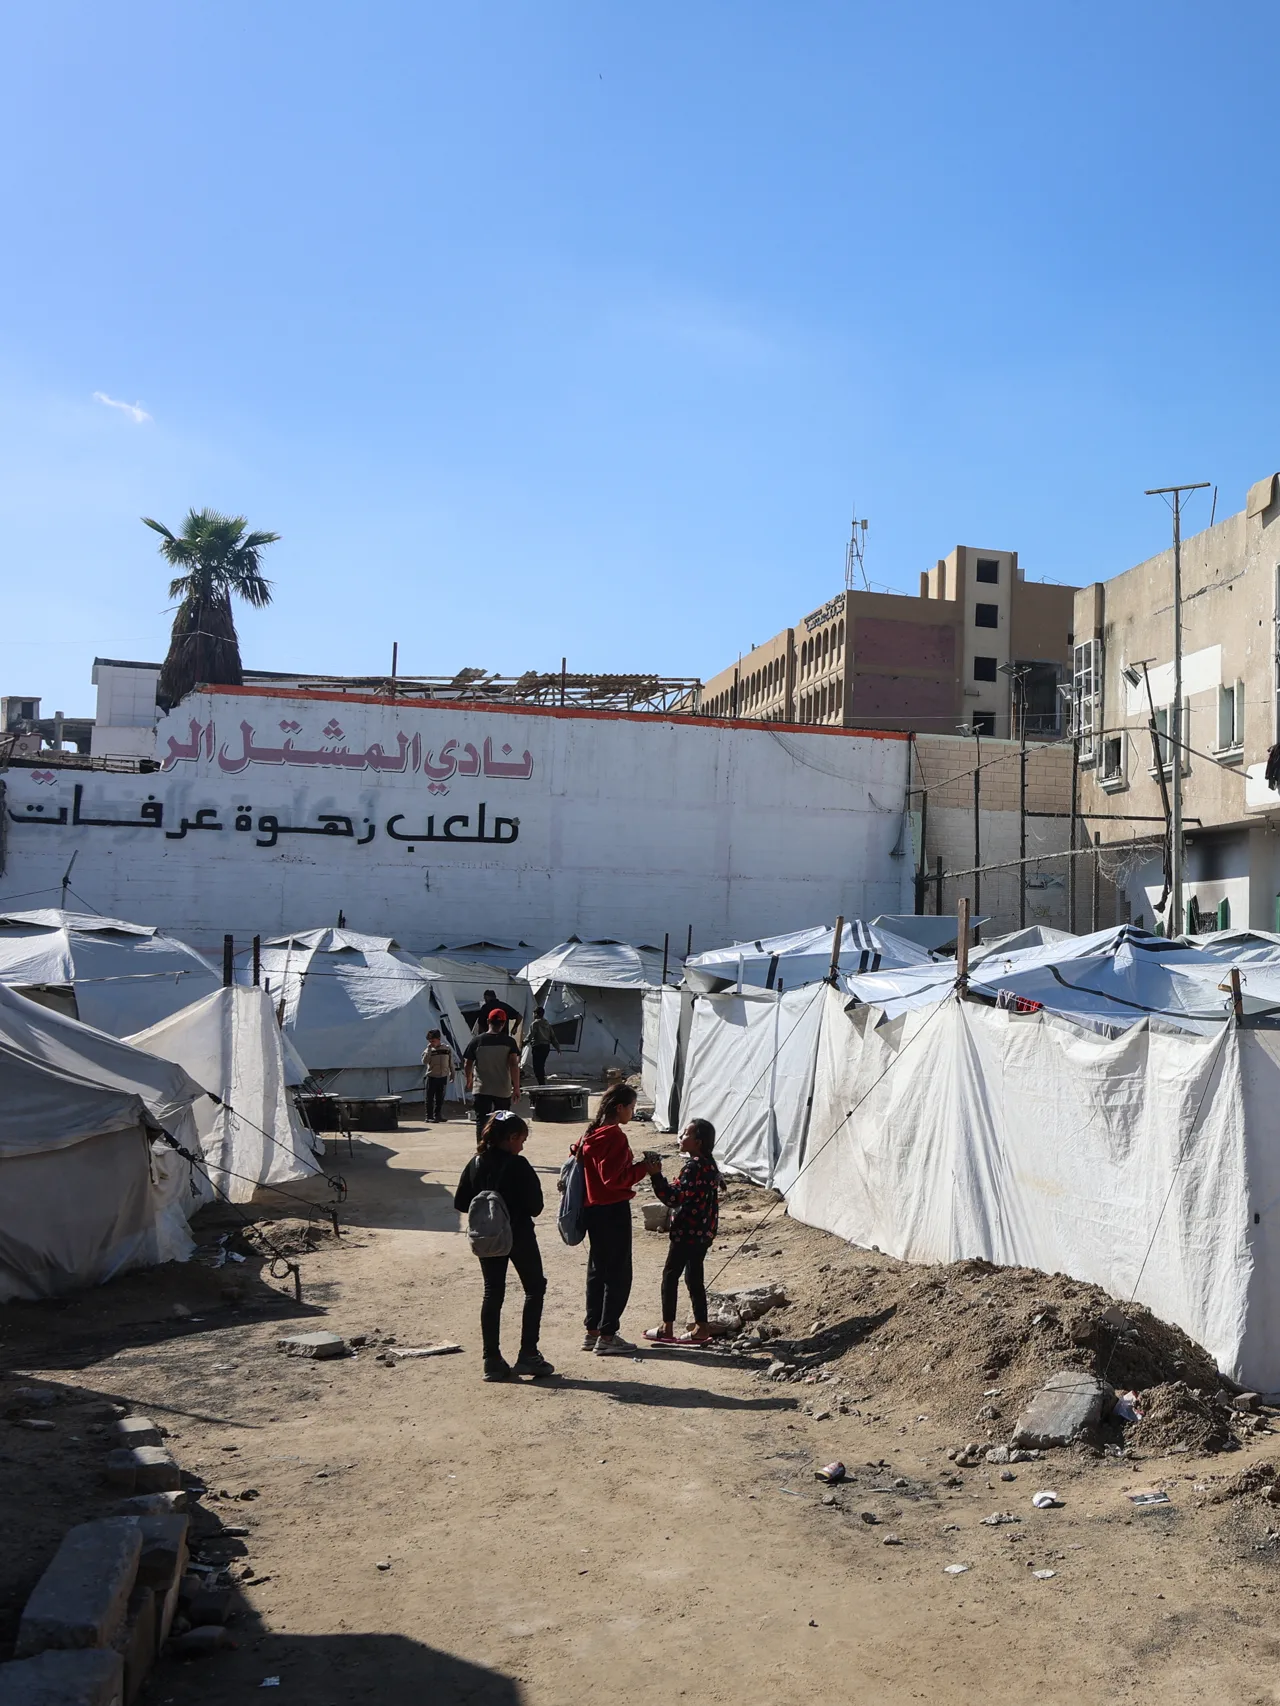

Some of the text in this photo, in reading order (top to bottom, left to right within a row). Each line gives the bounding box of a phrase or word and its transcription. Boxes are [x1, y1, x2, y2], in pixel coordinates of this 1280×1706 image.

[218, 718, 422, 775] المشتل
[424, 735, 533, 796] نادي
[7, 784, 520, 852] ملعب زهوة عرفات
